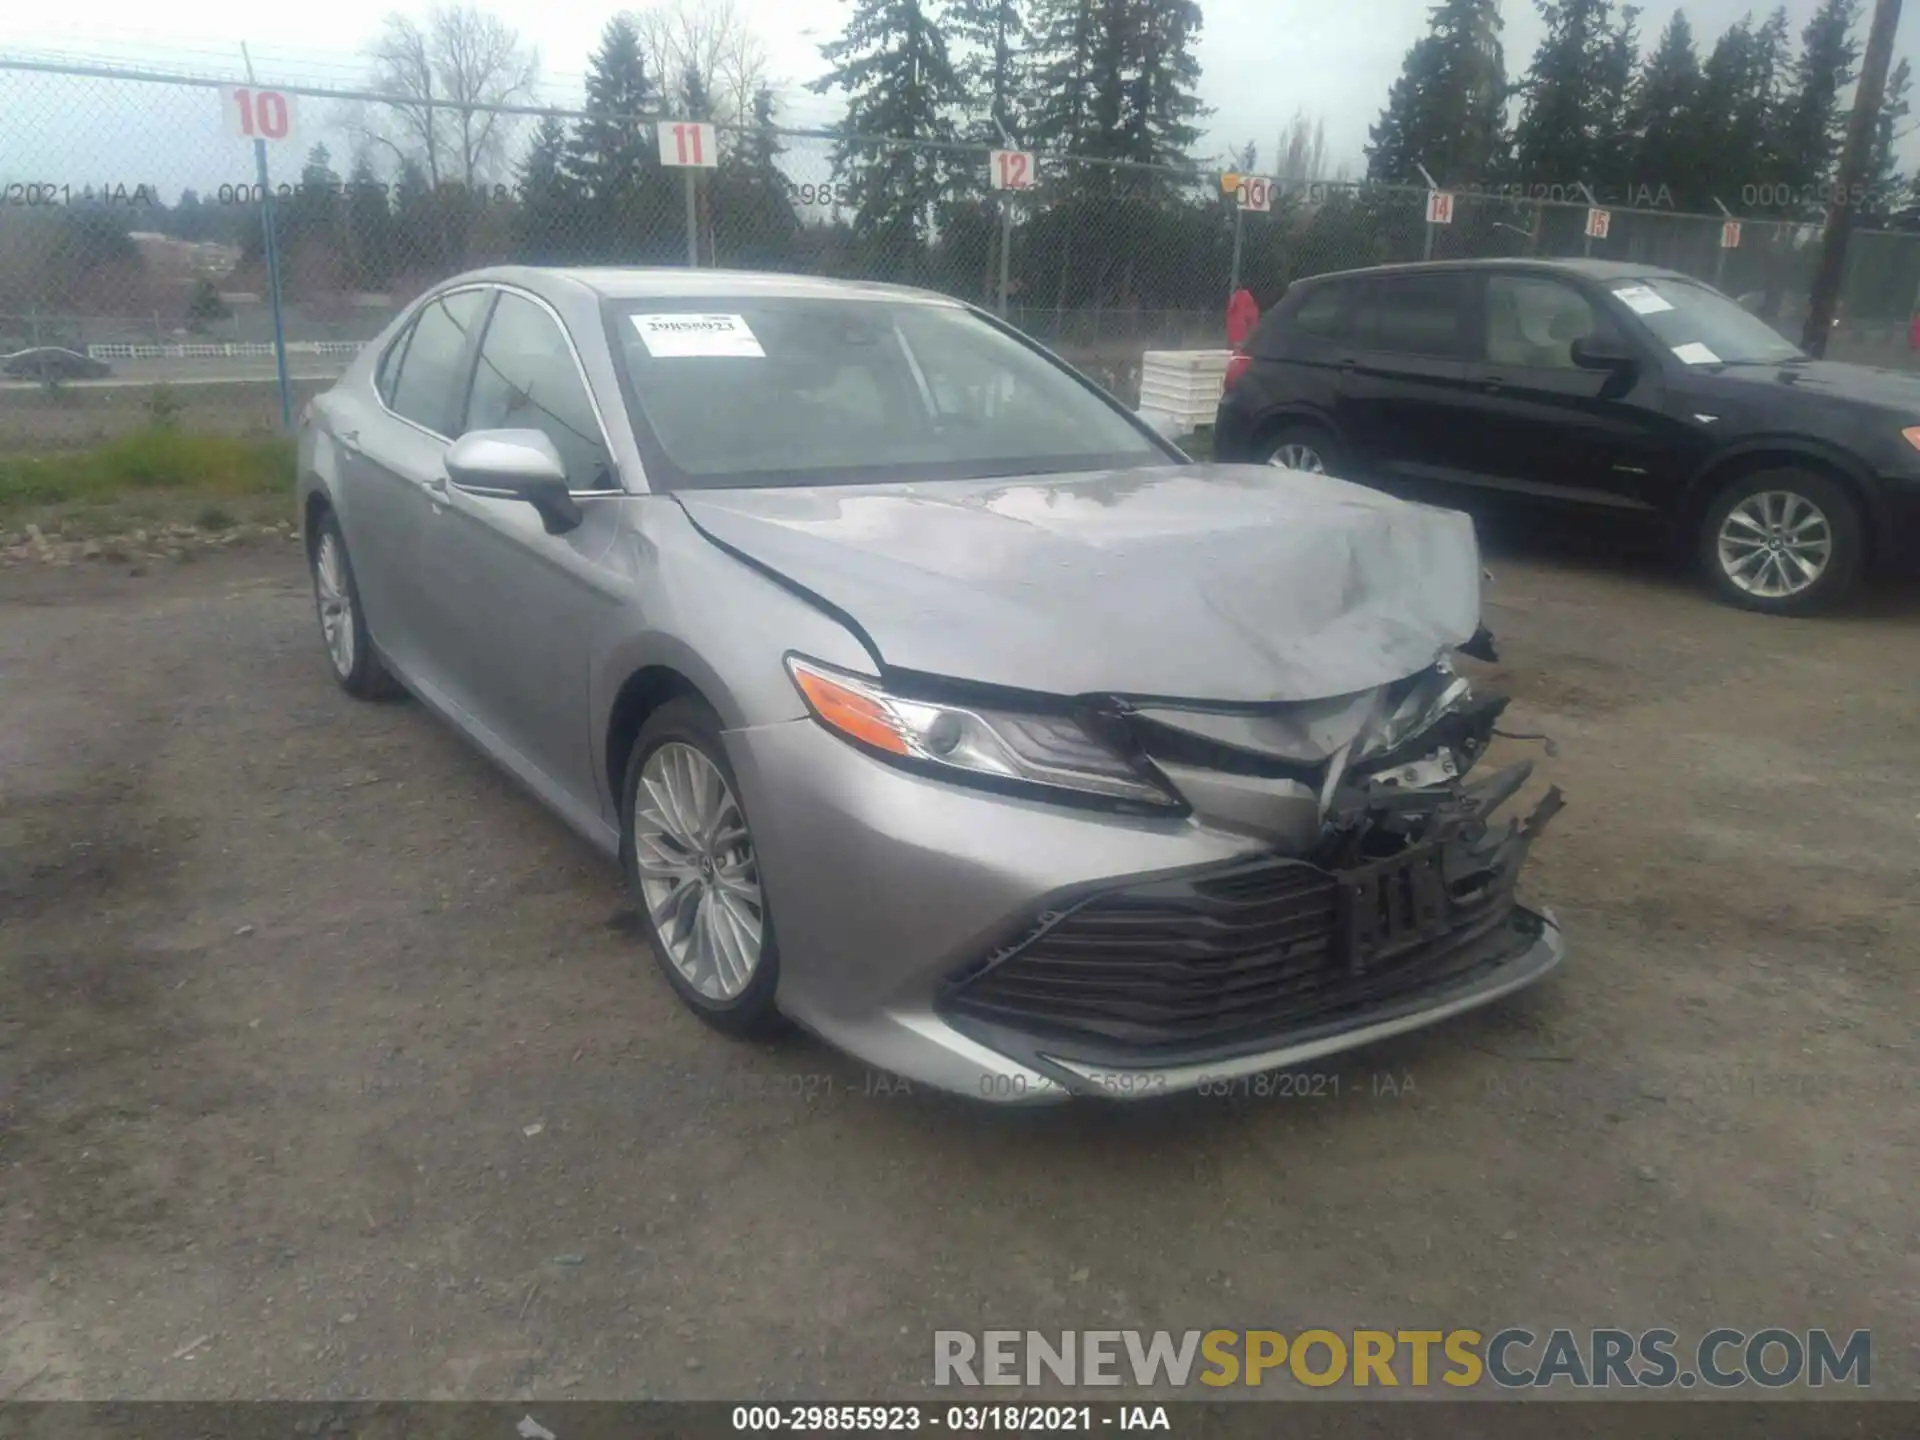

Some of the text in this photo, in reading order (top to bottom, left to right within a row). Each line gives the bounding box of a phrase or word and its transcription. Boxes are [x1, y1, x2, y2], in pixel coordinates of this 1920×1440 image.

[234, 90, 288, 138] 10
[673, 124, 702, 164] 11
[999, 153, 1027, 188] 12
